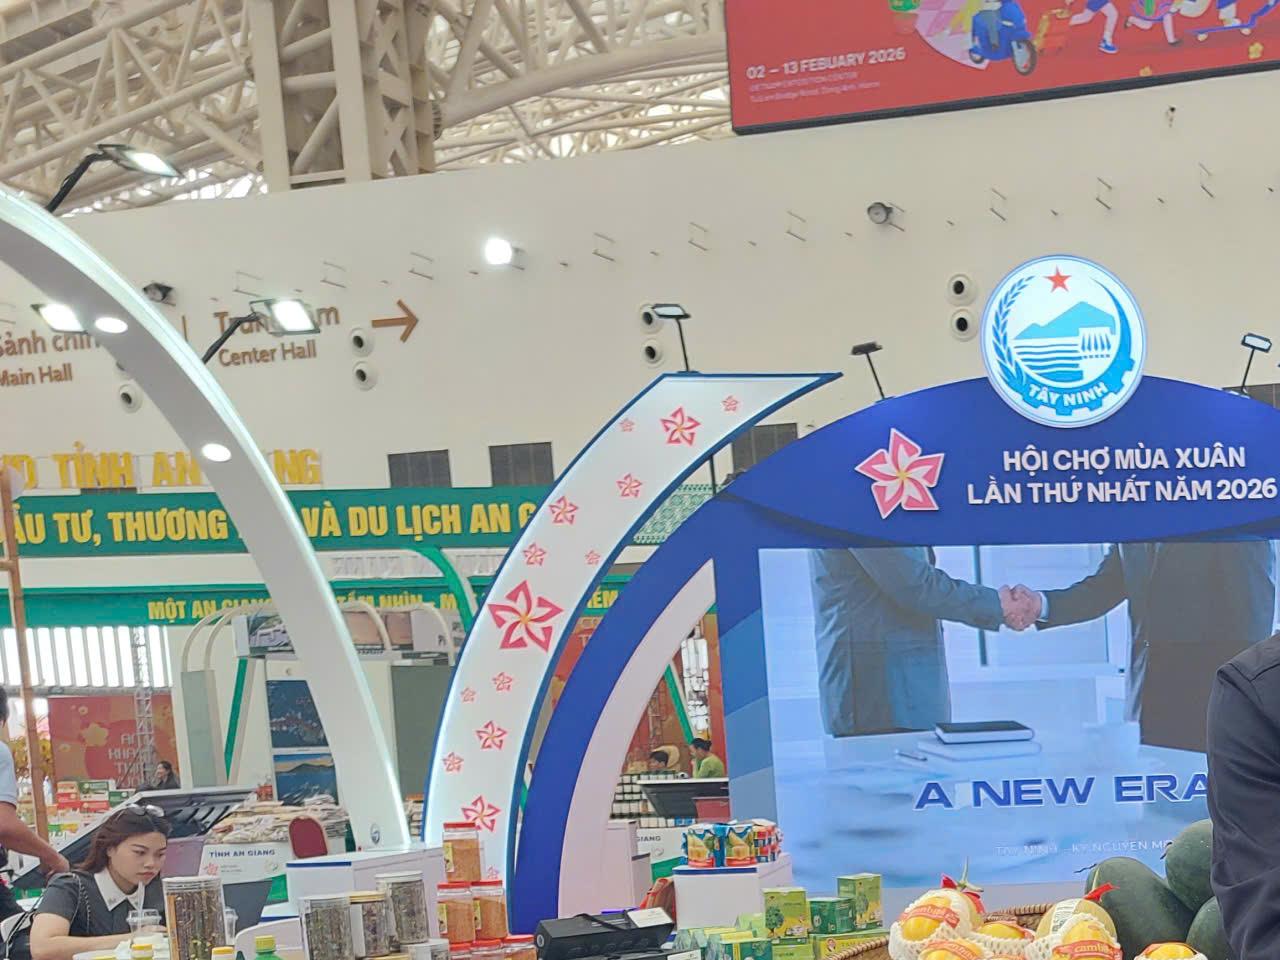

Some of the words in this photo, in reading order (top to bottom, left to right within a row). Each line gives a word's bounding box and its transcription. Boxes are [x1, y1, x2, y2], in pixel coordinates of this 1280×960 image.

[218, 348, 277, 367] Center
[281, 340, 317, 359] Hall
[39, 363, 73, 383] Hall
[1029, 385, 1060, 406] TÂY
[1063, 383, 1108, 407] NINH
[52, 441, 134, 489] TỈNH
[1003, 444, 1048, 476] HỘI
[1053, 446, 1110, 475] CHỢ
[1115, 442, 1169, 470] MÙA
[1175, 442, 1246, 469] XUÂN
[967, 475, 1022, 505] LẦN
[1027, 475, 1083, 504] THỨ
[1087, 473, 1151, 502] NHẤT
[1155, 476, 1212, 501] NĂM
[1216, 477, 1278, 500] 2026
[53, 509, 102, 546] TƯ,
[107, 508, 229, 542] THƯƠNG
[301, 501, 341, 538] VÀ
[348, 505, 388, 537] DU
[400, 503, 453, 541] LỊCH
[470, 504, 512, 535] AN
[148, 597, 186, 623] MỘT
[913, 780, 954, 811] A
[970, 775, 1095, 808] NEW
[1113, 772, 1208, 803] ERA
